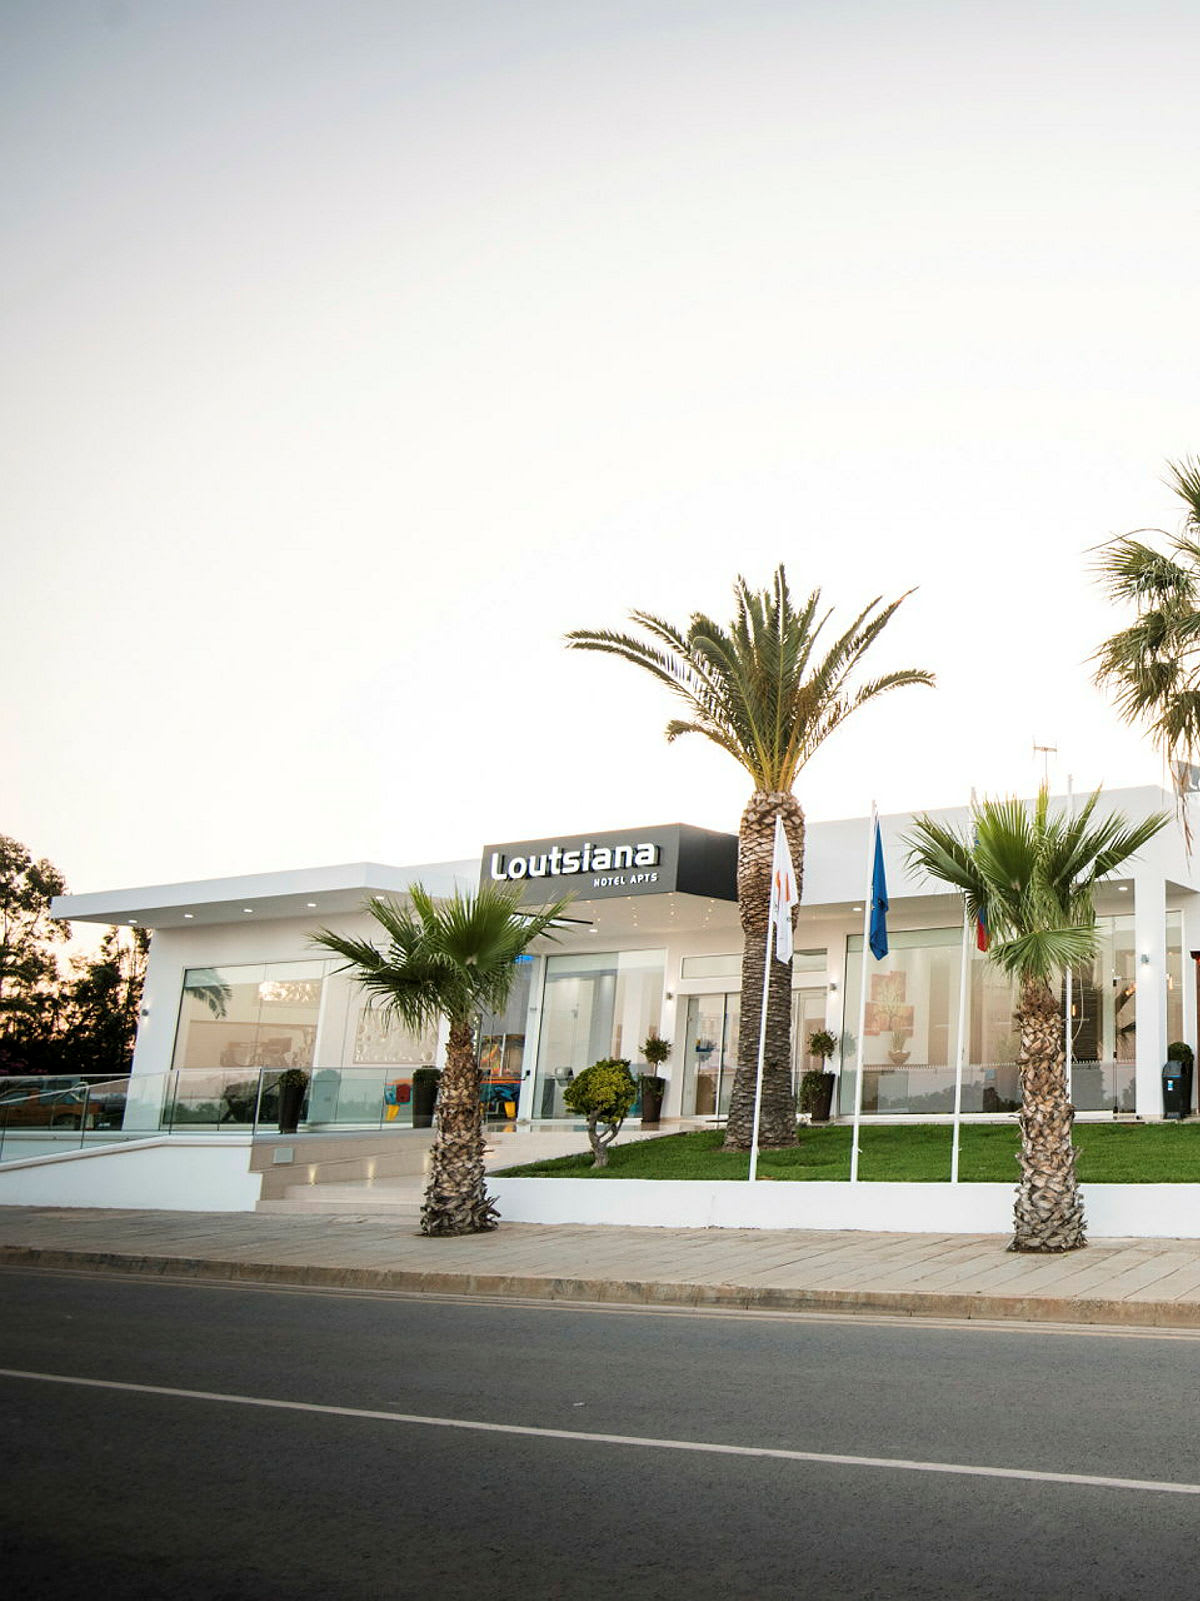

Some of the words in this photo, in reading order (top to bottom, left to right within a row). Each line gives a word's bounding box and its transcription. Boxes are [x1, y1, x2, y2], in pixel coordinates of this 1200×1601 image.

[491, 843, 658, 880] Loutsiana
[593, 876, 625, 888] HOTEL
[630, 873, 658, 884] APTS
